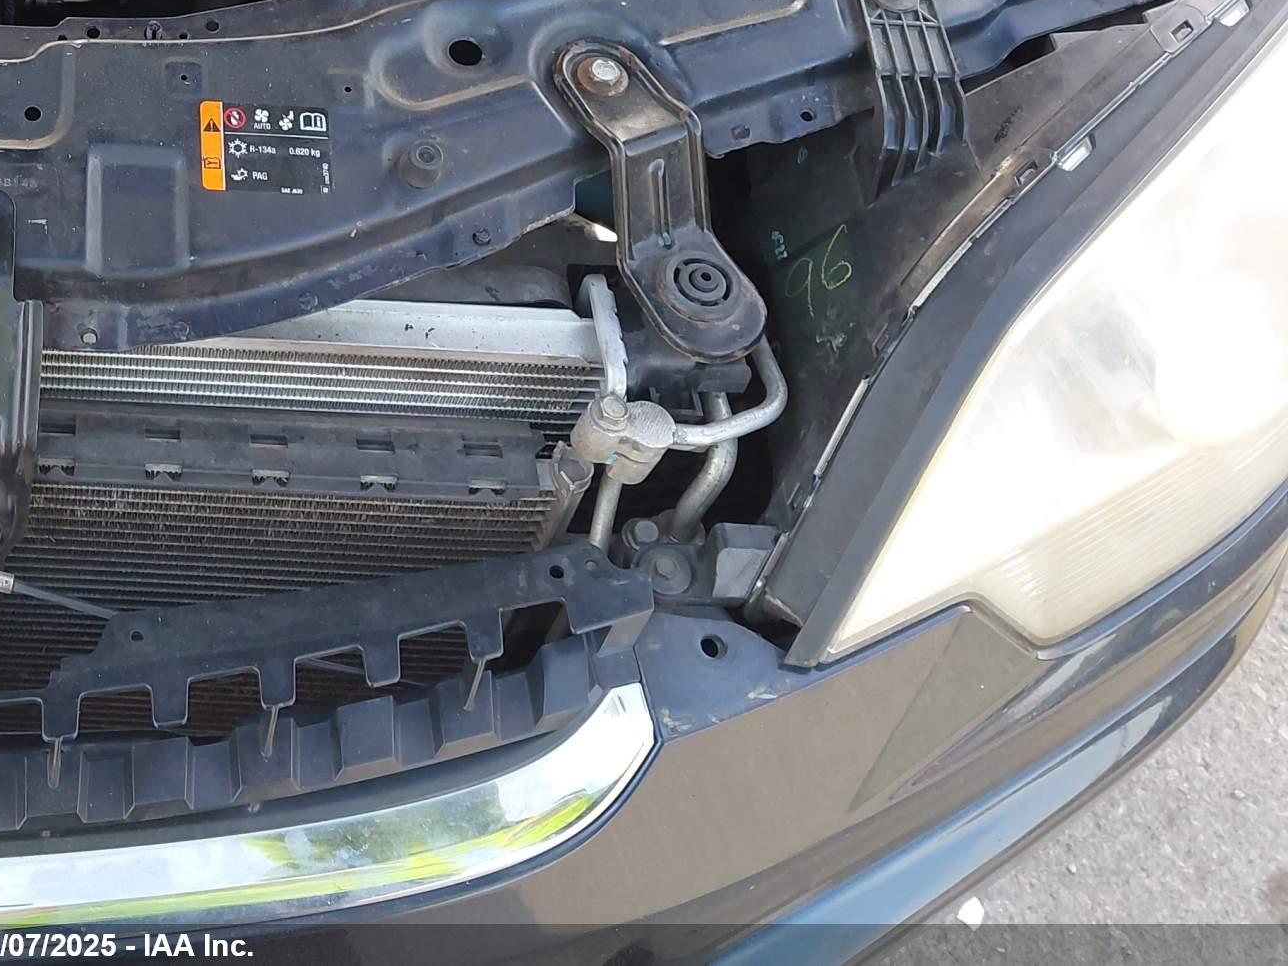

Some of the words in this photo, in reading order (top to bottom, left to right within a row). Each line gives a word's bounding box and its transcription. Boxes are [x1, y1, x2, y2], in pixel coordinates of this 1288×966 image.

[253, 122, 271, 130] AUTO
[250, 145, 277, 155] R-134a
[311, 148, 321, 158] kg
[252, 171, 268, 181] PAG
[785, 224, 853, 318] 96
